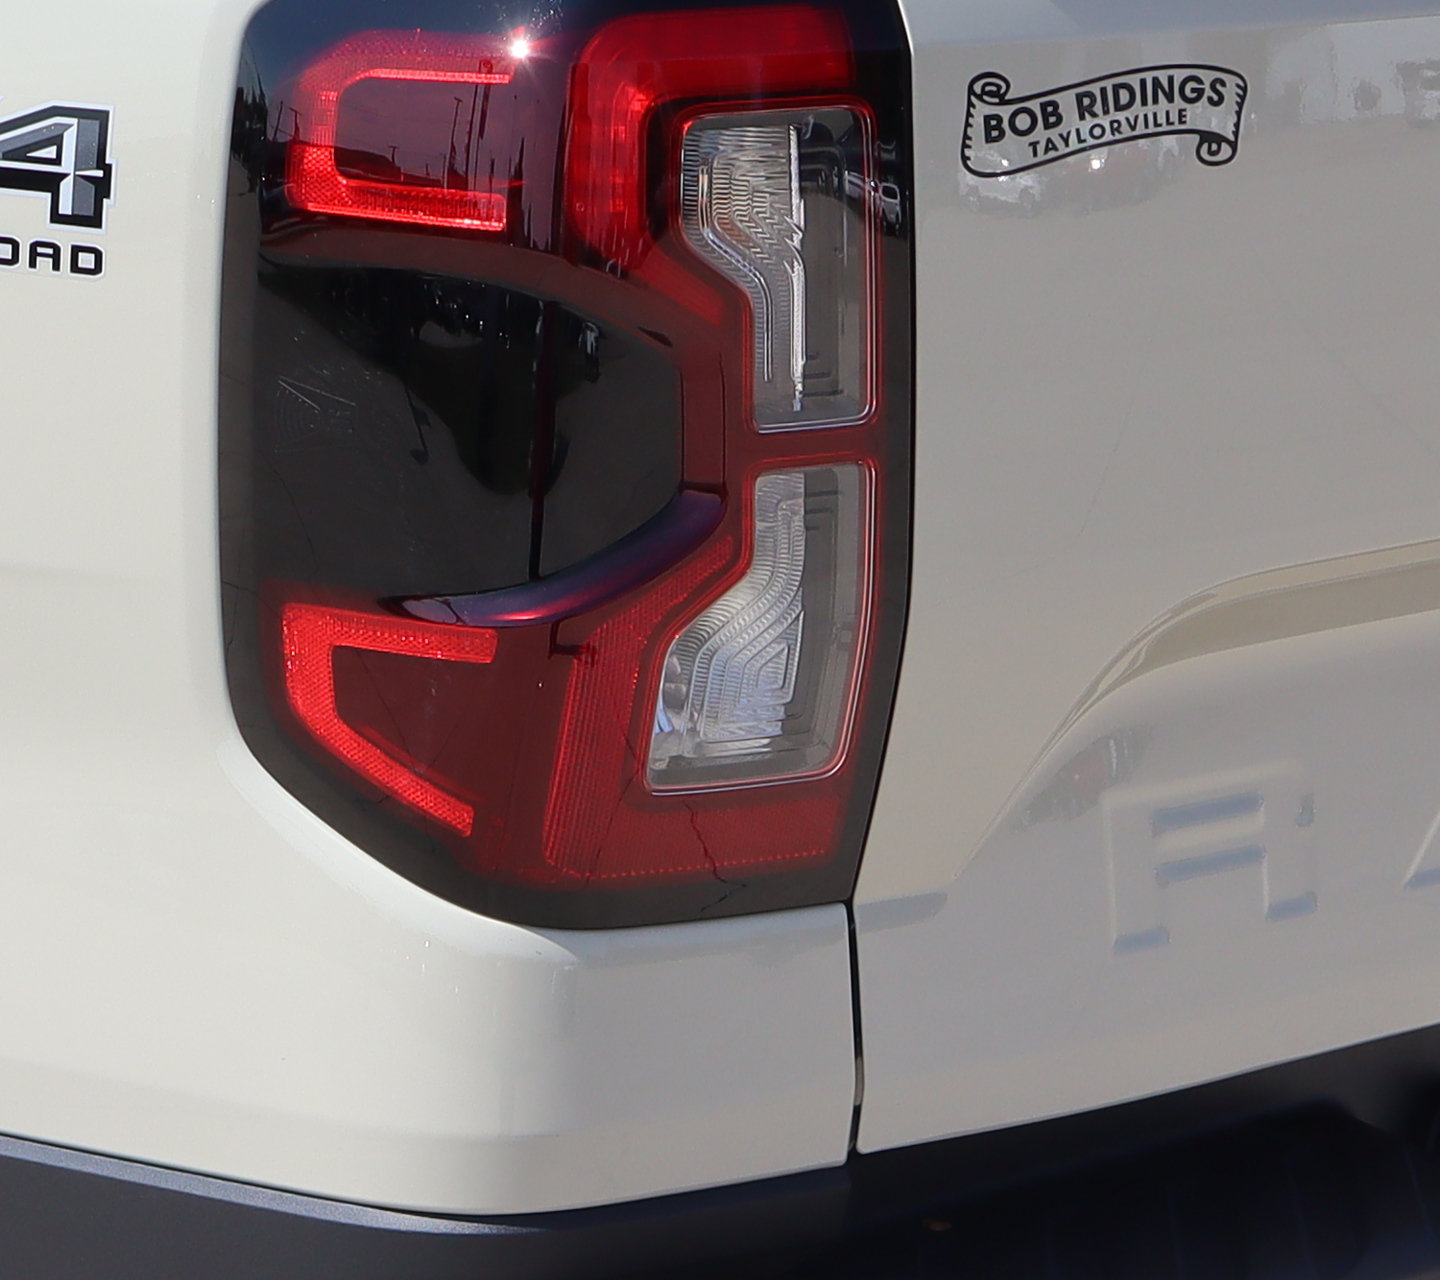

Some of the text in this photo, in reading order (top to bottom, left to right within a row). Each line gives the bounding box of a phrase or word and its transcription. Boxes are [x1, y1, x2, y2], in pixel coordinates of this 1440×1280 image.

[982, 74, 1228, 144] BOB RIDINGS
[1028, 107, 1188, 158] TAYLORVILLE
